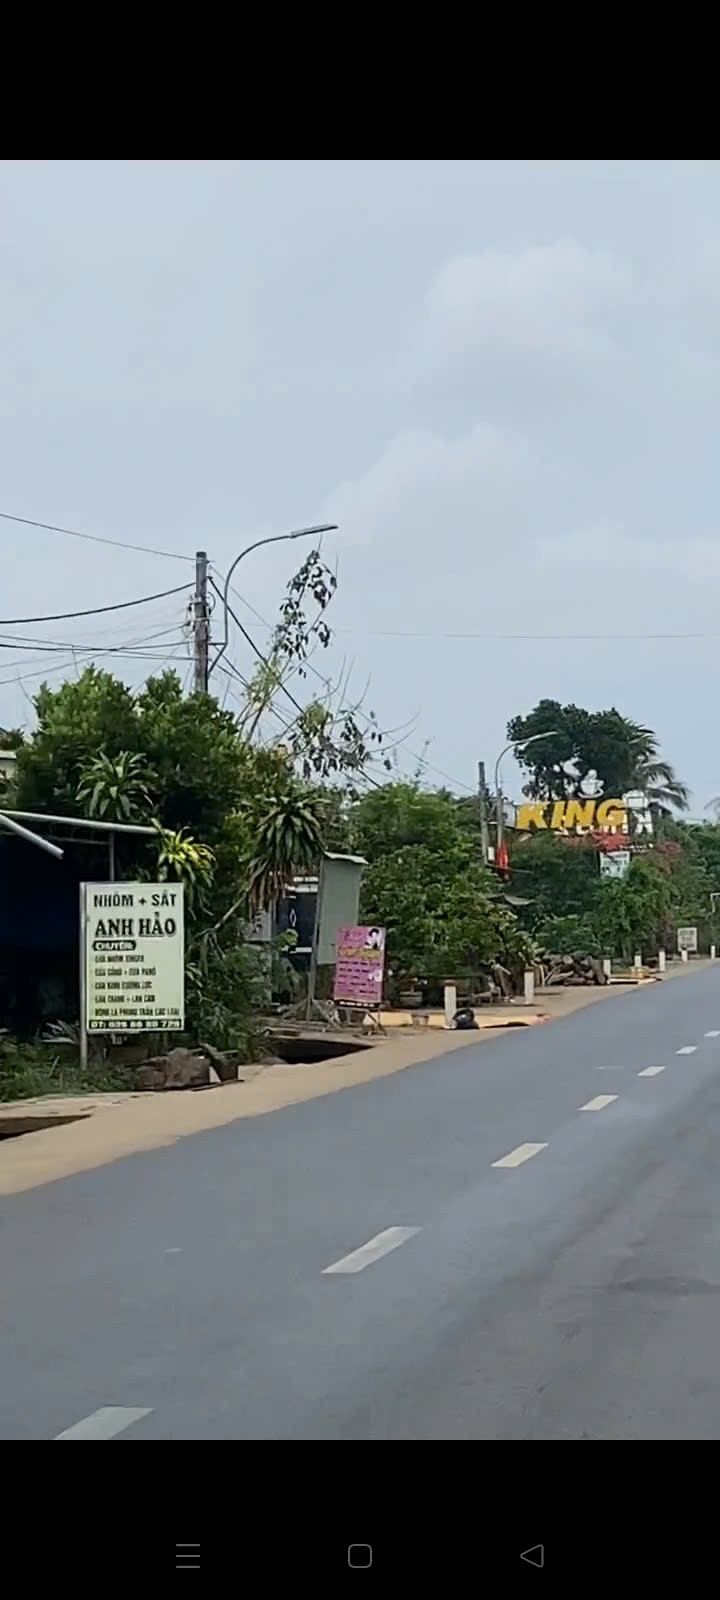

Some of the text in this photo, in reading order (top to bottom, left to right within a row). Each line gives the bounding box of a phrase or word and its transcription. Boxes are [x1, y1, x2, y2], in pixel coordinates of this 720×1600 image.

[516, 798, 628, 830] KING
[93, 891, 134, 907] NHÔM
[138, 897, 147, 906] +
[94, 911, 176, 938] ANH HẢO
